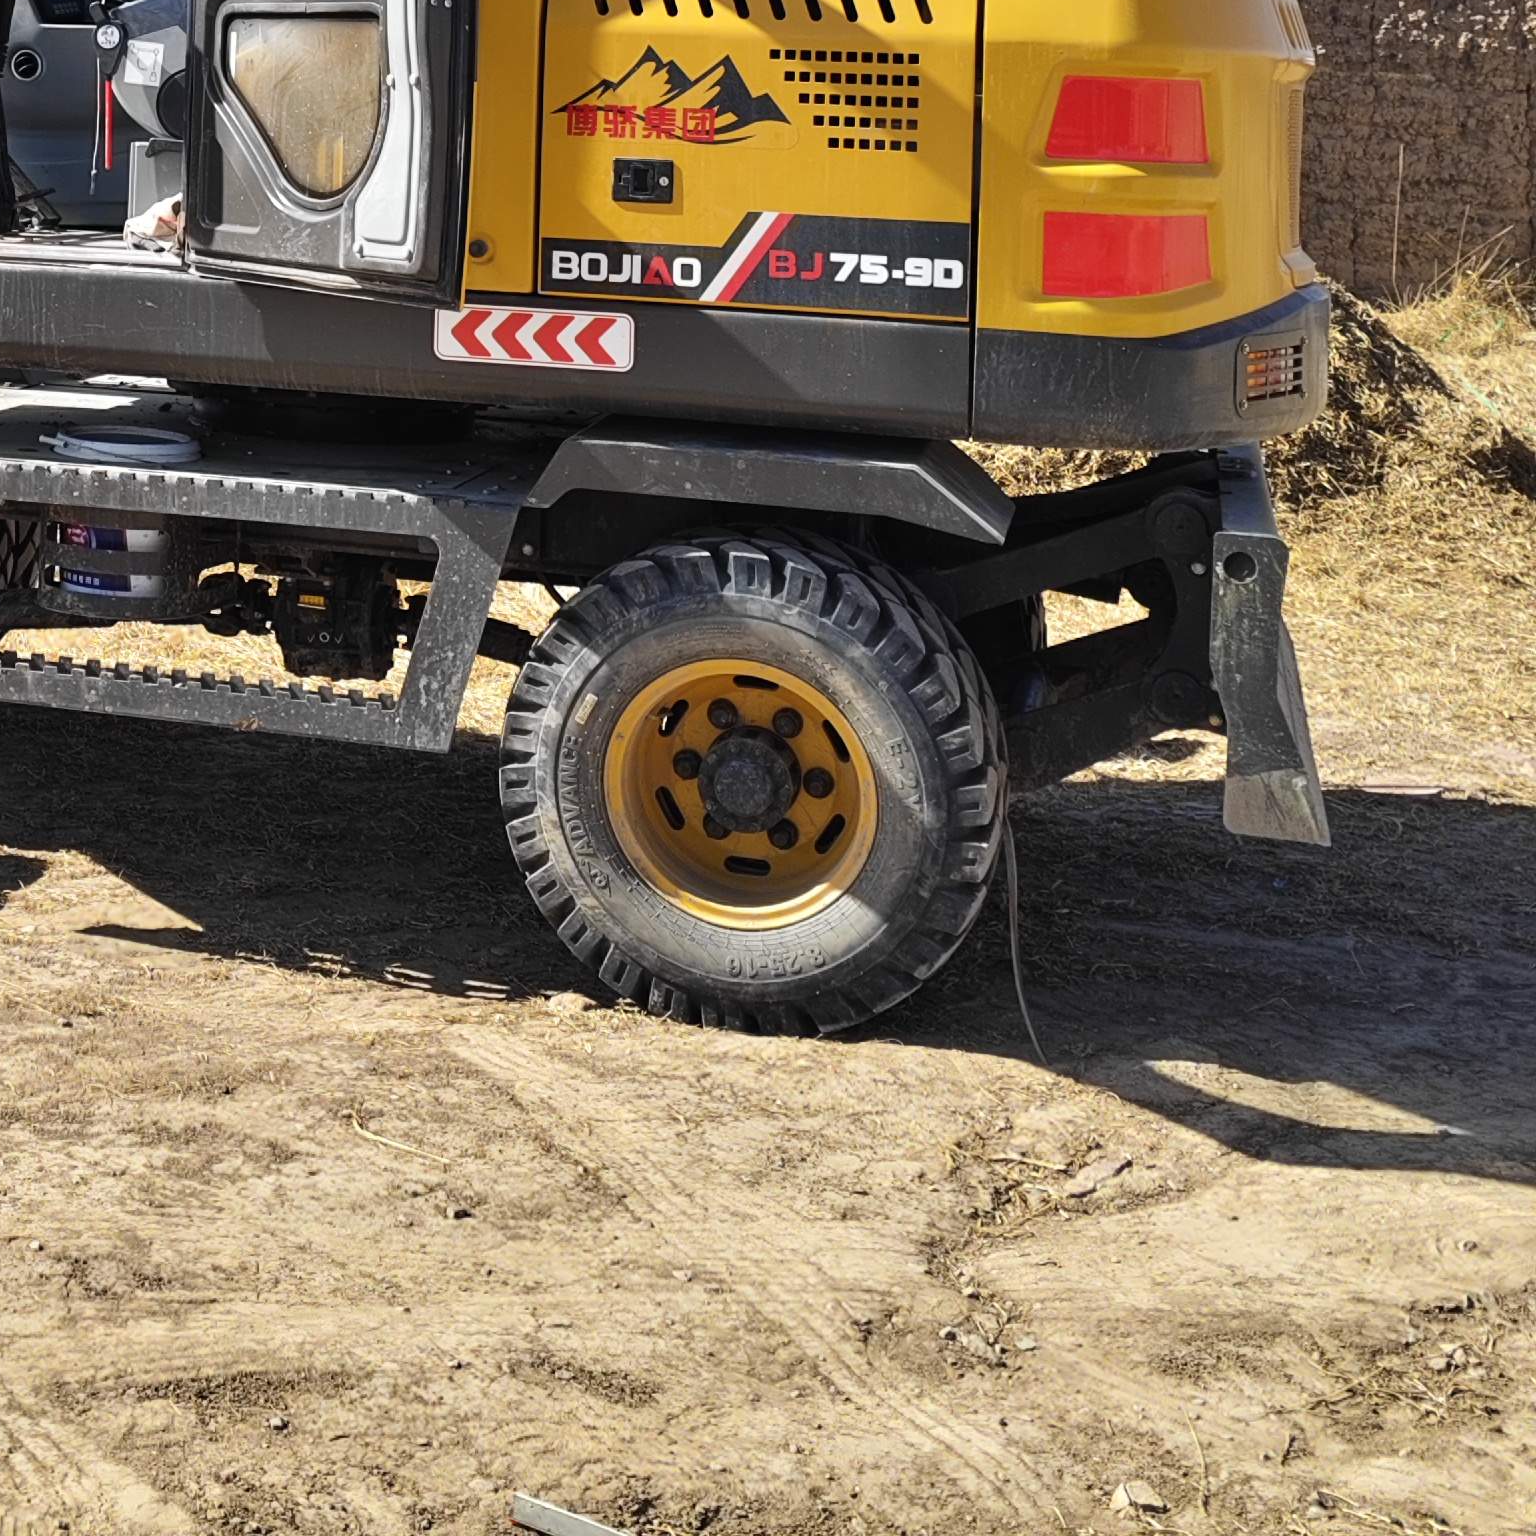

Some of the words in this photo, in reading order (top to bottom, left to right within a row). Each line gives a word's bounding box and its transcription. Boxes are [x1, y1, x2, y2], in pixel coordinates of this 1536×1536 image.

[566, 103, 716, 142] 博骄集团
[551, 250, 702, 288] BOJIAO
[561, 735, 595, 860] ADVANCE
[725, 946, 826, 978] 8.25-16
